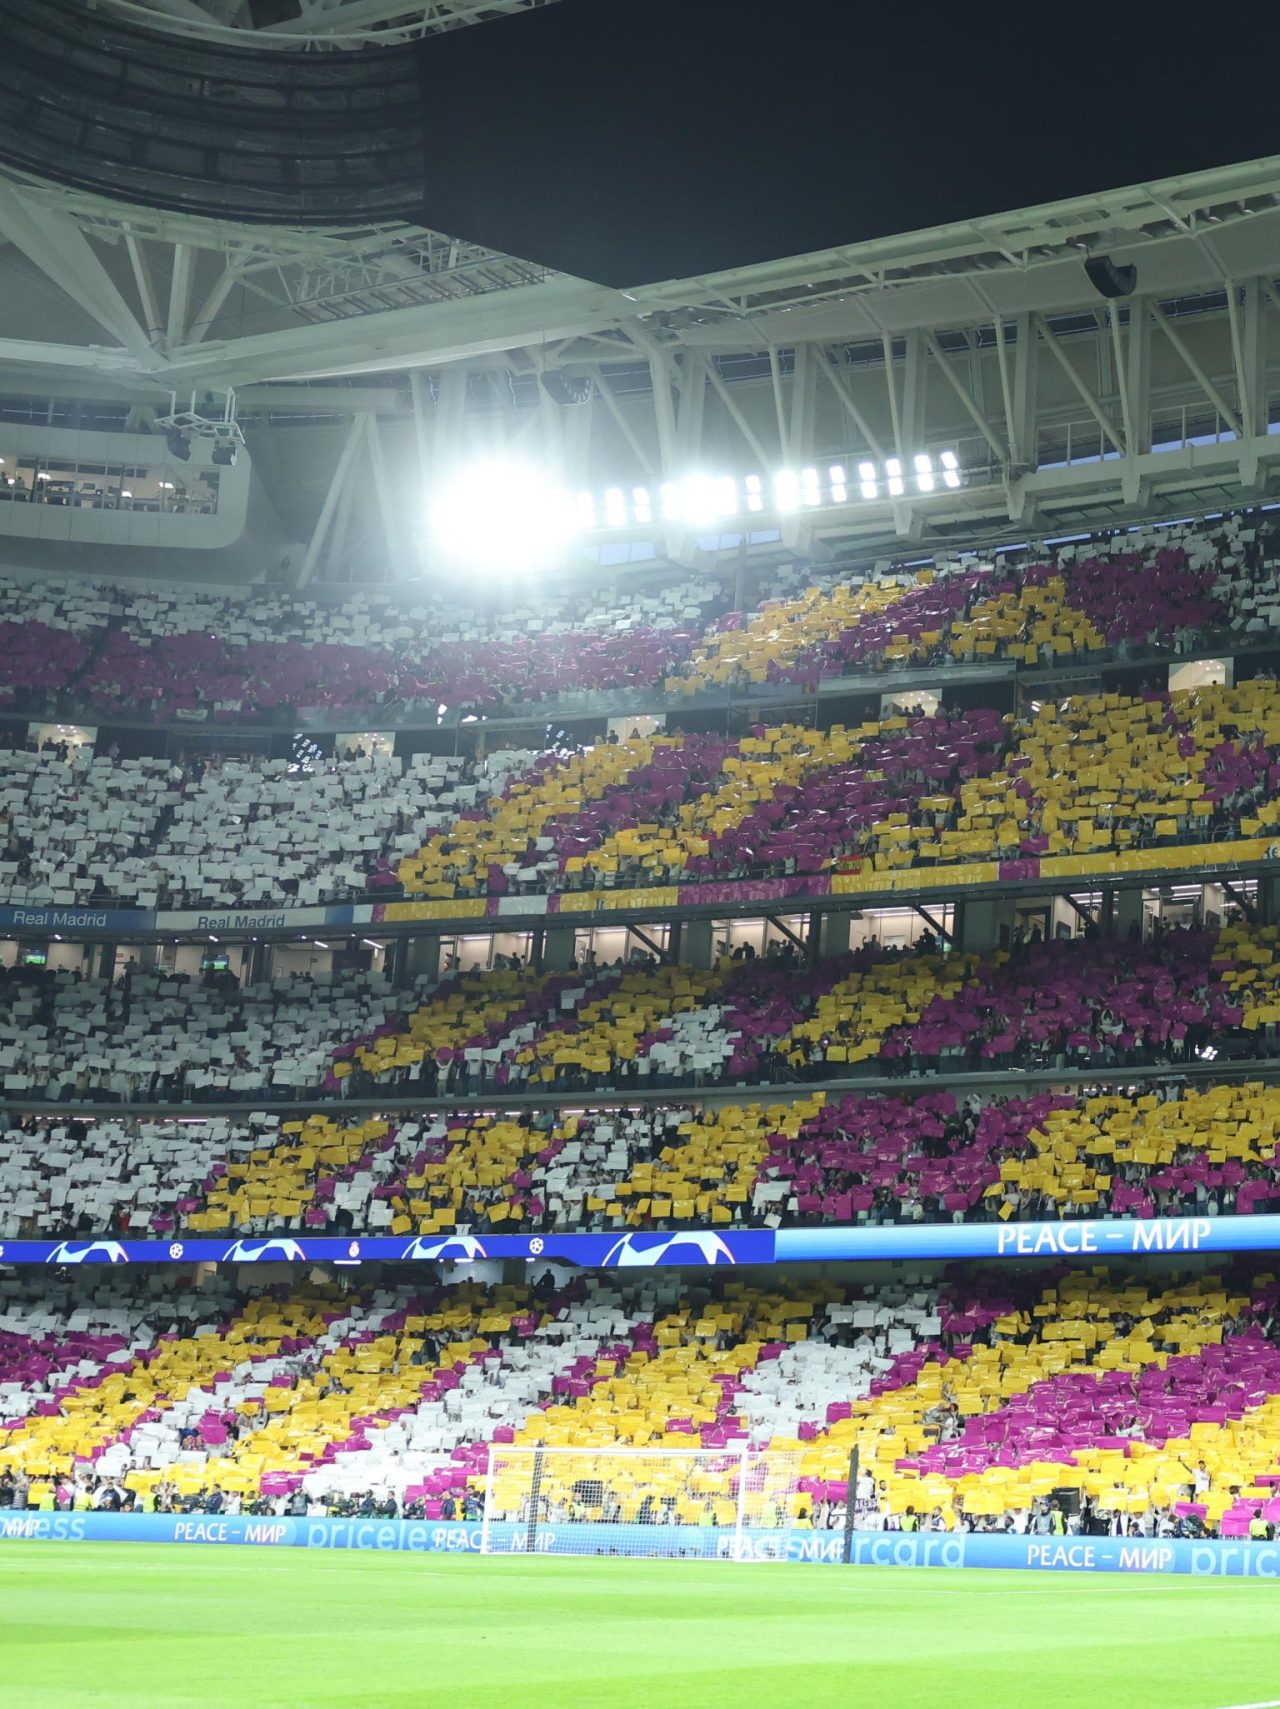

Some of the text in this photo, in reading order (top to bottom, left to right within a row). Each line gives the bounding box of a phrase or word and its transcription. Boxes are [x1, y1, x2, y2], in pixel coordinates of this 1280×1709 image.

[14, 911, 107, 926] Real Madrid
[197, 914, 285, 929] Real Madrid
[998, 1221, 1098, 1254] PEACE
[1132, 1219, 1212, 1250] МИР
[174, 1522, 228, 1541] PEACE
[244, 1524, 287, 1543] МИР
[1027, 1544, 1096, 1567] PEACE
[1118, 1547, 1172, 1569] МИР
